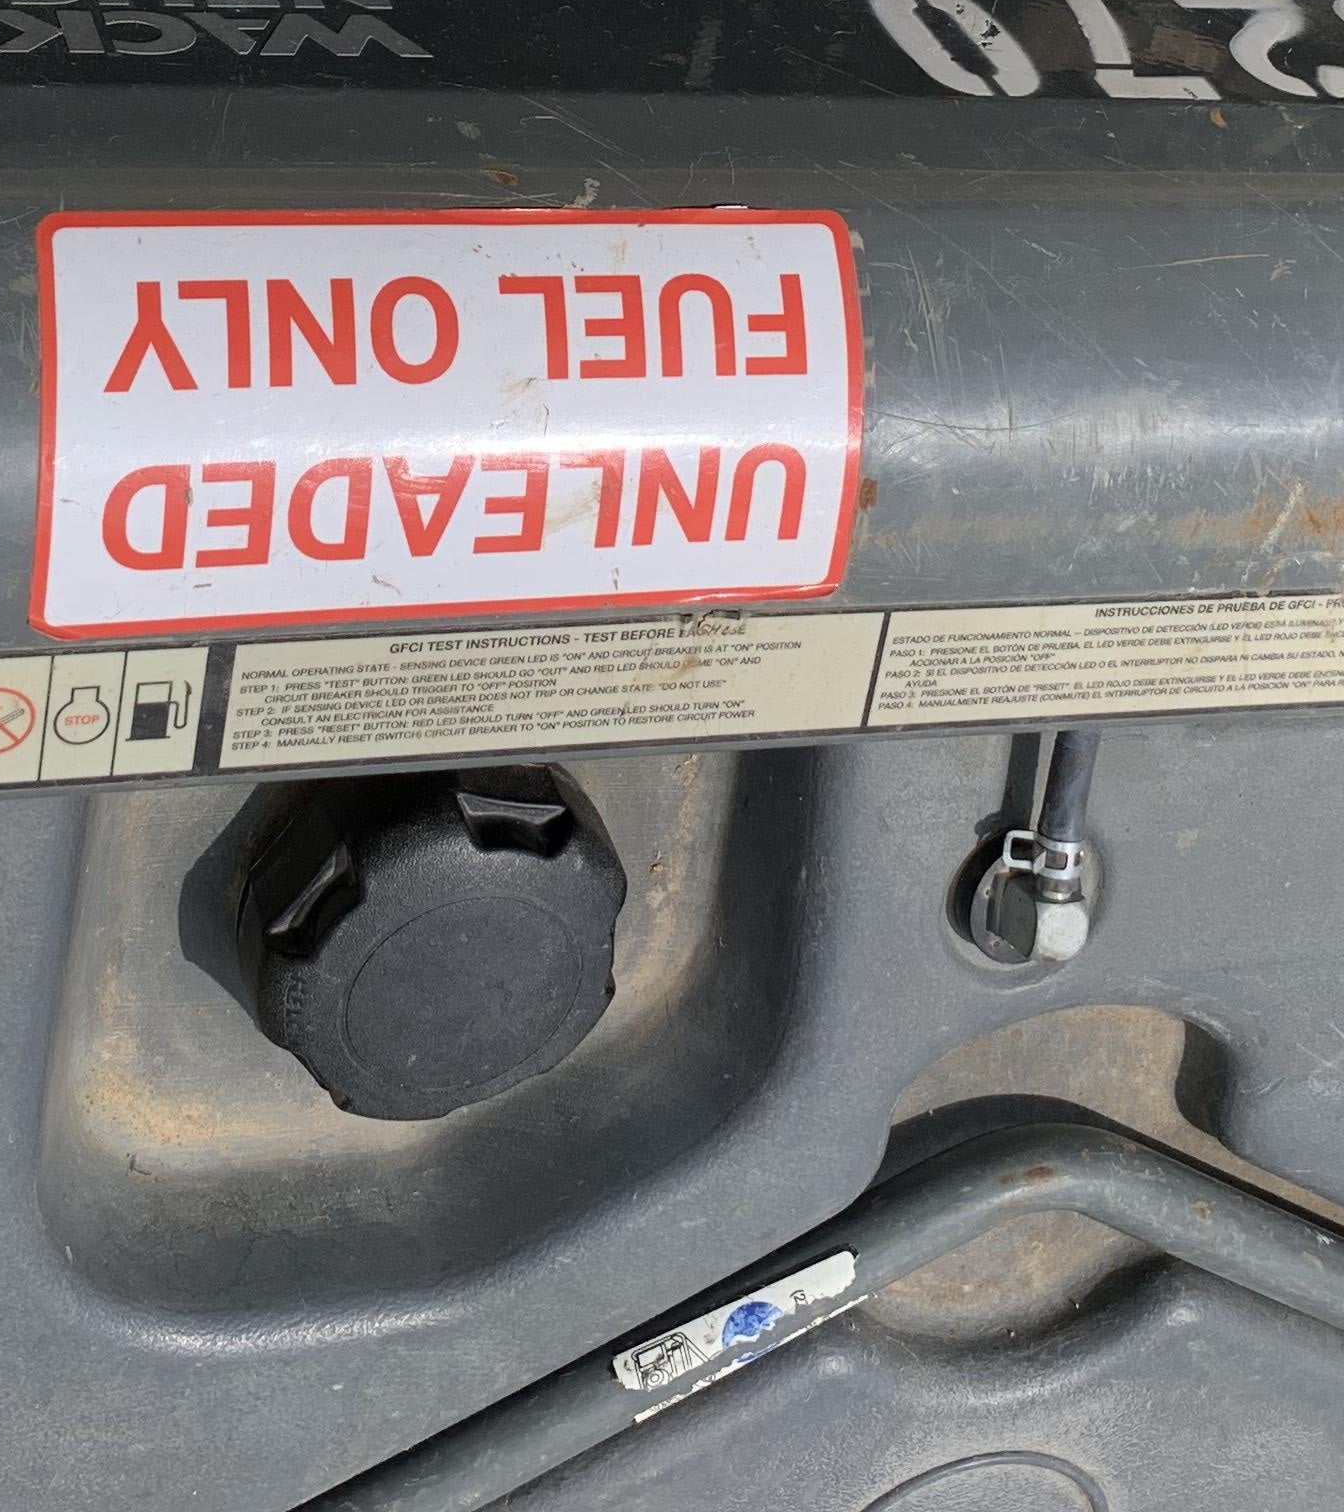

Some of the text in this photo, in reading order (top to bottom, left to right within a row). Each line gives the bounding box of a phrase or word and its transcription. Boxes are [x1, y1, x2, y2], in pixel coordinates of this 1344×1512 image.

[102, 272, 810, 394] FUEL ONLY
[101, 442, 808, 572] UNLEADED
[1094, 603, 1196, 618] INSTRUCCIONES
[1196, 602, 1215, 614] DE
[1215, 600, 1267, 613] PRUEBA
[1267, 600, 1286, 611] DE
[1286, 598, 1317, 610] GFCI
[389, 641, 423, 653] GFCI
[426, 639, 463, 651] TEST
[465, 633, 571, 649] INSTRUCTIONS
[583, 631, 617, 643] TEST
[619, 627, 675, 641] BEFORE
[239, 683, 268, 694] STEP
[284, 680, 321, 691] PRESS
[323, 678, 360, 689] "TEST"
[361, 675, 409, 687] BUTTON:
[410, 673, 448, 684] GREEN
[449, 672, 471, 682] LED
[472, 669, 517, 681] SHOULD
[535, 666, 568, 677] "OUT"
[568, 665, 592, 675] AND
[592, 664, 615, 674] RED
[615, 662, 637, 672] LED
[637, 660, 681, 671] SHOULD
[714, 657, 738, 666] "ON"
[739, 655, 761, 665] AND
[240, 668, 289, 680] NORMAL
[290, 664, 354, 677] OPERATING
[355, 662, 391, 674] STATE
[398, 659, 447, 671] SENSING
[447, 657, 487, 668] DEVICE
[488, 655, 526, 666] GREEN
[526, 654, 548, 664] LED
[560, 652, 586, 662] "ON"
[587, 650, 610, 661] AND
[610, 648, 651, 659] CIRCUIT
[653, 645, 702, 657] BREAKER
[729, 643, 754, 653] "ON"
[754, 640, 802, 651] POSITION
[235, 706, 264, 717] STEP
[292, 701, 342, 713] SENSING
[343, 699, 383, 710] DEVICE
[384, 698, 407, 708] LED
[425, 693, 477, 705] BREAKER
[477, 692, 508, 702] DOES
[508, 690, 530, 700] NOT
[534, 689, 557, 699] TRIP
[575, 685, 620, 696] CHANGE
[620, 683, 656, 693] STATE:
[657, 682, 678, 691] "DO
[677, 680, 701, 690] NOT
[701, 679, 726, 689] USE"
[263, 692, 308, 704] CIRCUIT
[310, 689, 362, 701] BREAKER
[363, 686, 409, 698] SHOULD
[409, 683, 458, 695] TRIGGER
[475, 680, 506, 691] "OFF"
[507, 677, 557, 689] POSITION
[63, 712, 101, 727] STOP
[230, 740, 260, 751] STEP
[275, 735, 335, 748] MANUALLY
[337, 733, 371, 744] RESET
[373, 730, 423, 742] (SWITCH)
[423, 727, 466, 738] CIRCUIT
[467, 724, 518, 736] BREAKER
[535, 721, 561, 731] "ON"
[561, 718, 610, 729] POSITION
[627, 713, 675, 725] RESTORE
[675, 711, 716, 722] CIRCUIT
[717, 708, 755, 719] POWER
[232, 728, 261, 739] STEP
[277, 725, 315, 736] PRESS
[316, 722, 360, 734] "RESET"
[362, 719, 409, 731] BUTTON:
[411, 718, 434, 728] RED
[435, 716, 457, 726] LED
[458, 713, 503, 725] SHOULD
[505, 711, 534, 722] TURN
[534, 710, 564, 720] "OFF"
[565, 708, 588, 718] AND
[588, 706, 627, 717] GREEN
[625, 704, 647, 714] LED
[648, 702, 690, 713] SHOULD
[692, 700, 720, 710] TURN
[720, 698, 745, 708] "ON"
[260, 714, 313, 726] CONSULT
[332, 709, 403, 722] ELECTRICIAN
[404, 707, 427, 717] FOR
[428, 703, 494, 716] ASSISTANCE
